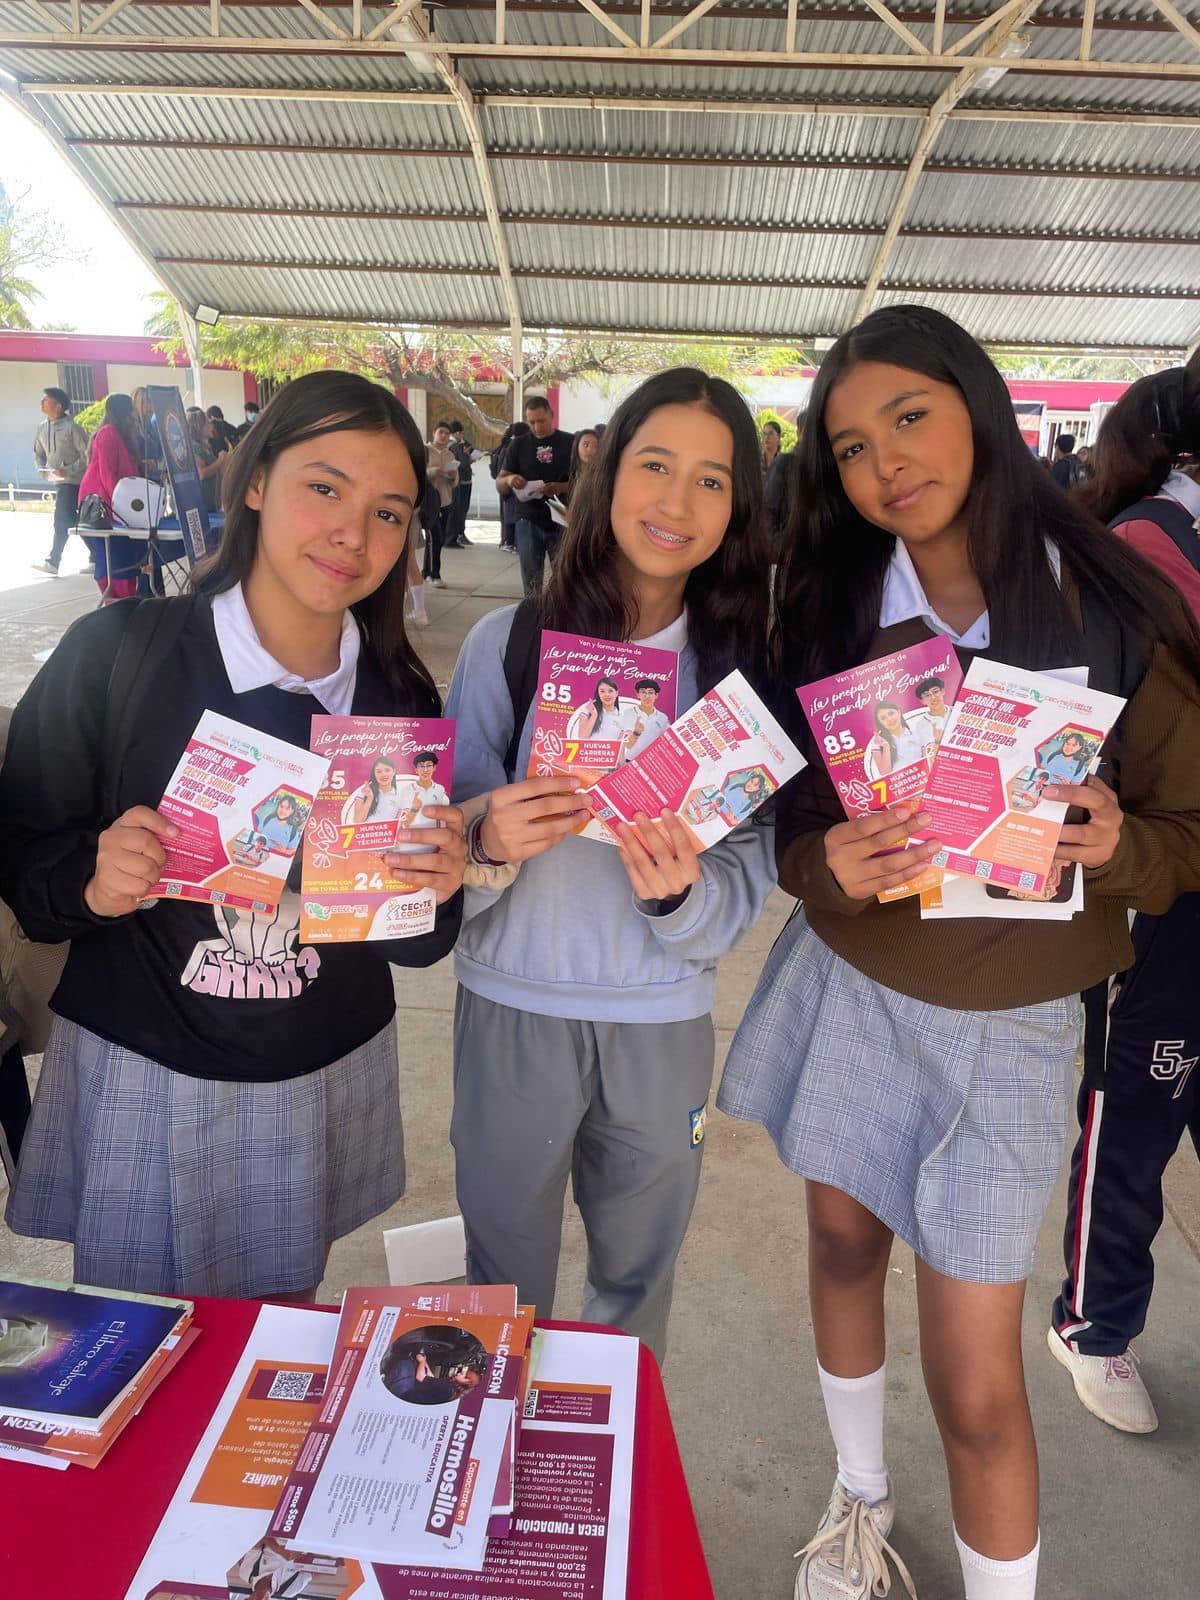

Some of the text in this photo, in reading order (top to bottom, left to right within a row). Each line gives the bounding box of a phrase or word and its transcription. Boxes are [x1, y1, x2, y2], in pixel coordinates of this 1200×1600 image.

[596, 642, 615, 650] forma
[616, 645, 632, 654] parte
[566, 653, 605, 661] prepa
[606, 655, 635, 664] más
[550, 662, 672, 680] grande de Sonora!
[835, 674, 849, 684] Ven
[854, 663, 876, 676] forma
[876, 657, 896, 670] parte
[896, 652, 906, 661] de
[541, 681, 572, 703] 85
[833, 679, 869, 706] prepa
[874, 663, 902, 687] más
[825, 690, 870, 731] grande
[876, 680, 891, 702] de
[898, 654, 950, 694] Sonora!
[998, 701, 1016, 713] QUE
[960, 702, 1031, 728] COMO ALUMNO DE
[340, 732, 381, 744] prepa
[384, 729, 413, 740] más
[684, 717, 721, 762] PUEDES ACCEDER
[822, 727, 857, 756] 85
[948, 734, 956, 743] A
[955, 736, 972, 747] UNA
[952, 724, 1017, 747] PUEDES ACCEDER
[380, 741, 397, 755] de
[401, 737, 450, 755] Sonora!
[565, 742, 579, 762] 7
[187, 754, 249, 787] COMO ALUMNO DE
[220, 757, 237, 770] QUE
[888, 769, 926, 791] CARRERAS
[889, 766, 918, 782] NUEVAS
[172, 785, 180, 795] A
[178, 788, 195, 801] UNA
[177, 775, 235, 805] PUEDES ACCEDER
[871, 779, 891, 804] 7
[894, 776, 928, 796] TÉCNICAS
[340, 827, 354, 848] 7
[357, 837, 391, 845] TÉCNICAS
[352, 871, 383, 891] 24
[49, 1321, 126, 1395] El libro salvaje
[487, 1344, 509, 1394] ICATSON
[424, 1415, 449, 1484] OFERTA EDUCATIVA
[545, 1452, 595, 1462] manteniendo
[429, 1415, 477, 1529] Hermosillo
[521, 1467, 564, 1477] noviembre,
[538, 1459, 595, 1470] recibes $1,900
[241, 1471, 282, 1488] JUÁREZ
[532, 1476, 579, 1485] convocatoria
[572, 1470, 594, 1478] mayo
[456, 1462, 477, 1521] Capacítate en
[563, 1486, 593, 1495] estudio
[520, 1501, 591, 1513] Promedio mínimo
[573, 1496, 592, 1504] beca
[283, 1507, 297, 1531] $500
[515, 1518, 604, 1536] BECA FUNDACIÓN
[500, 1538, 532, 1547] servicio
[545, 1542, 588, 1552] realizando
[516, 1548, 587, 1561] respectivamente,
[398, 1568, 409, 1576] de
[508, 1558, 585, 1571] $2,000 mensuales
[519, 1568, 538, 1576] eres
[411, 1569, 429, 1577] mes
[440, 1571, 472, 1581] durante
[474, 1574, 502, 1584] realiza
[504, 1576, 514, 1584] se
[516, 1577, 571, 1589] convocatoria
[408, 1588, 427, 1597] esta
[429, 1589, 448, 1598] para
